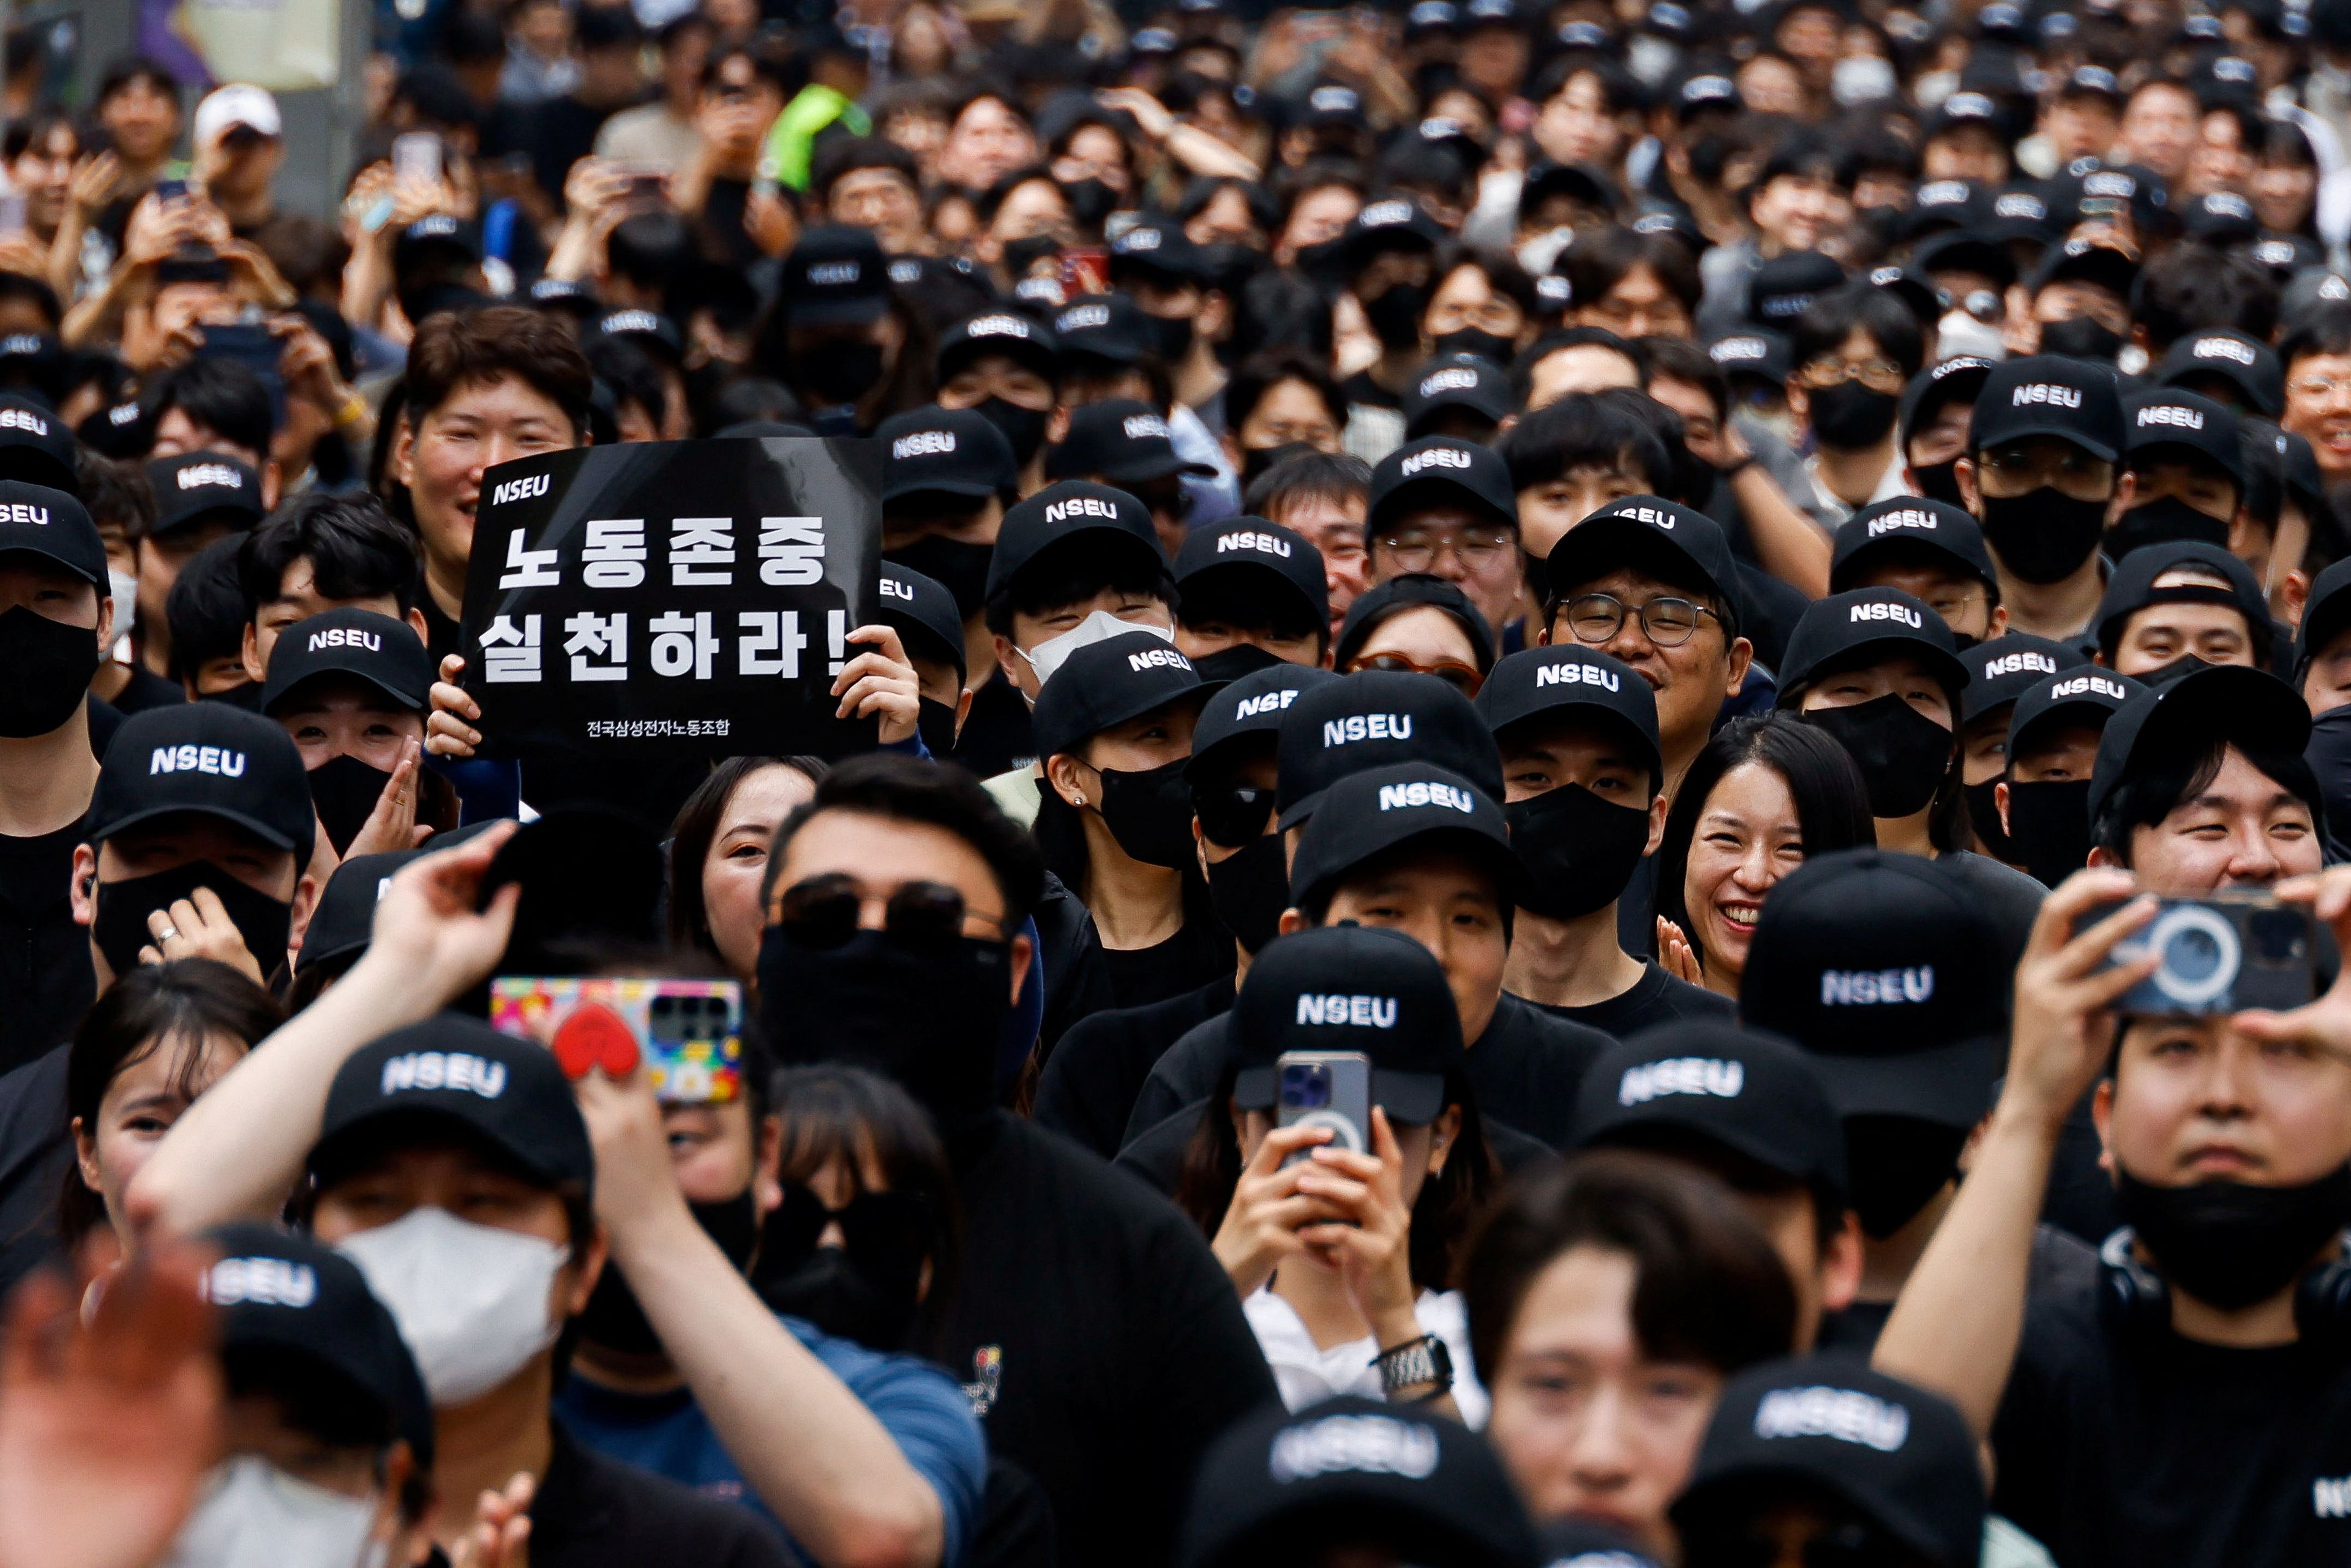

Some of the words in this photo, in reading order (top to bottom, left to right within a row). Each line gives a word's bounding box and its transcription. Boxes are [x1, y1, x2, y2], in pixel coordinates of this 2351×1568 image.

[2013, 384, 2081, 408] NSEU
[0, 410, 47, 435] SEU
[2137, 406, 2203, 429] NSEU
[893, 432, 956, 459] NSEU
[1401, 449, 1471, 476] NSEU
[493, 474, 550, 505] NSEU
[0, 505, 48, 524] SEU
[1046, 498, 1117, 523] NSEU
[1868, 509, 1937, 537] NSEU
[1217, 533, 1291, 557] NSEU
[881, 579, 913, 601] EU
[1851, 603, 1921, 628] NSEU
[309, 629, 380, 651] NSEU
[1128, 650, 1193, 672] NSEU
[1986, 652, 2056, 679] NSEU
[1537, 664, 1618, 692] NSEU
[2052, 677, 2124, 699] NSEU
[1236, 690, 1298, 721] NSE
[588, 719, 730, 737] 전국삼성전자노동조합
[1324, 714, 1411, 748] NSEU
[150, 745, 244, 777] NSEU
[1379, 782, 1472, 812] NSEU
[1823, 966, 1932, 1005] NSEU
[1297, 994, 1396, 1027] NSEU
[382, 1052, 505, 1098] NSEU
[1619, 1057, 1743, 1106] NSEU
[199, 1257, 317, 1307] SEU
